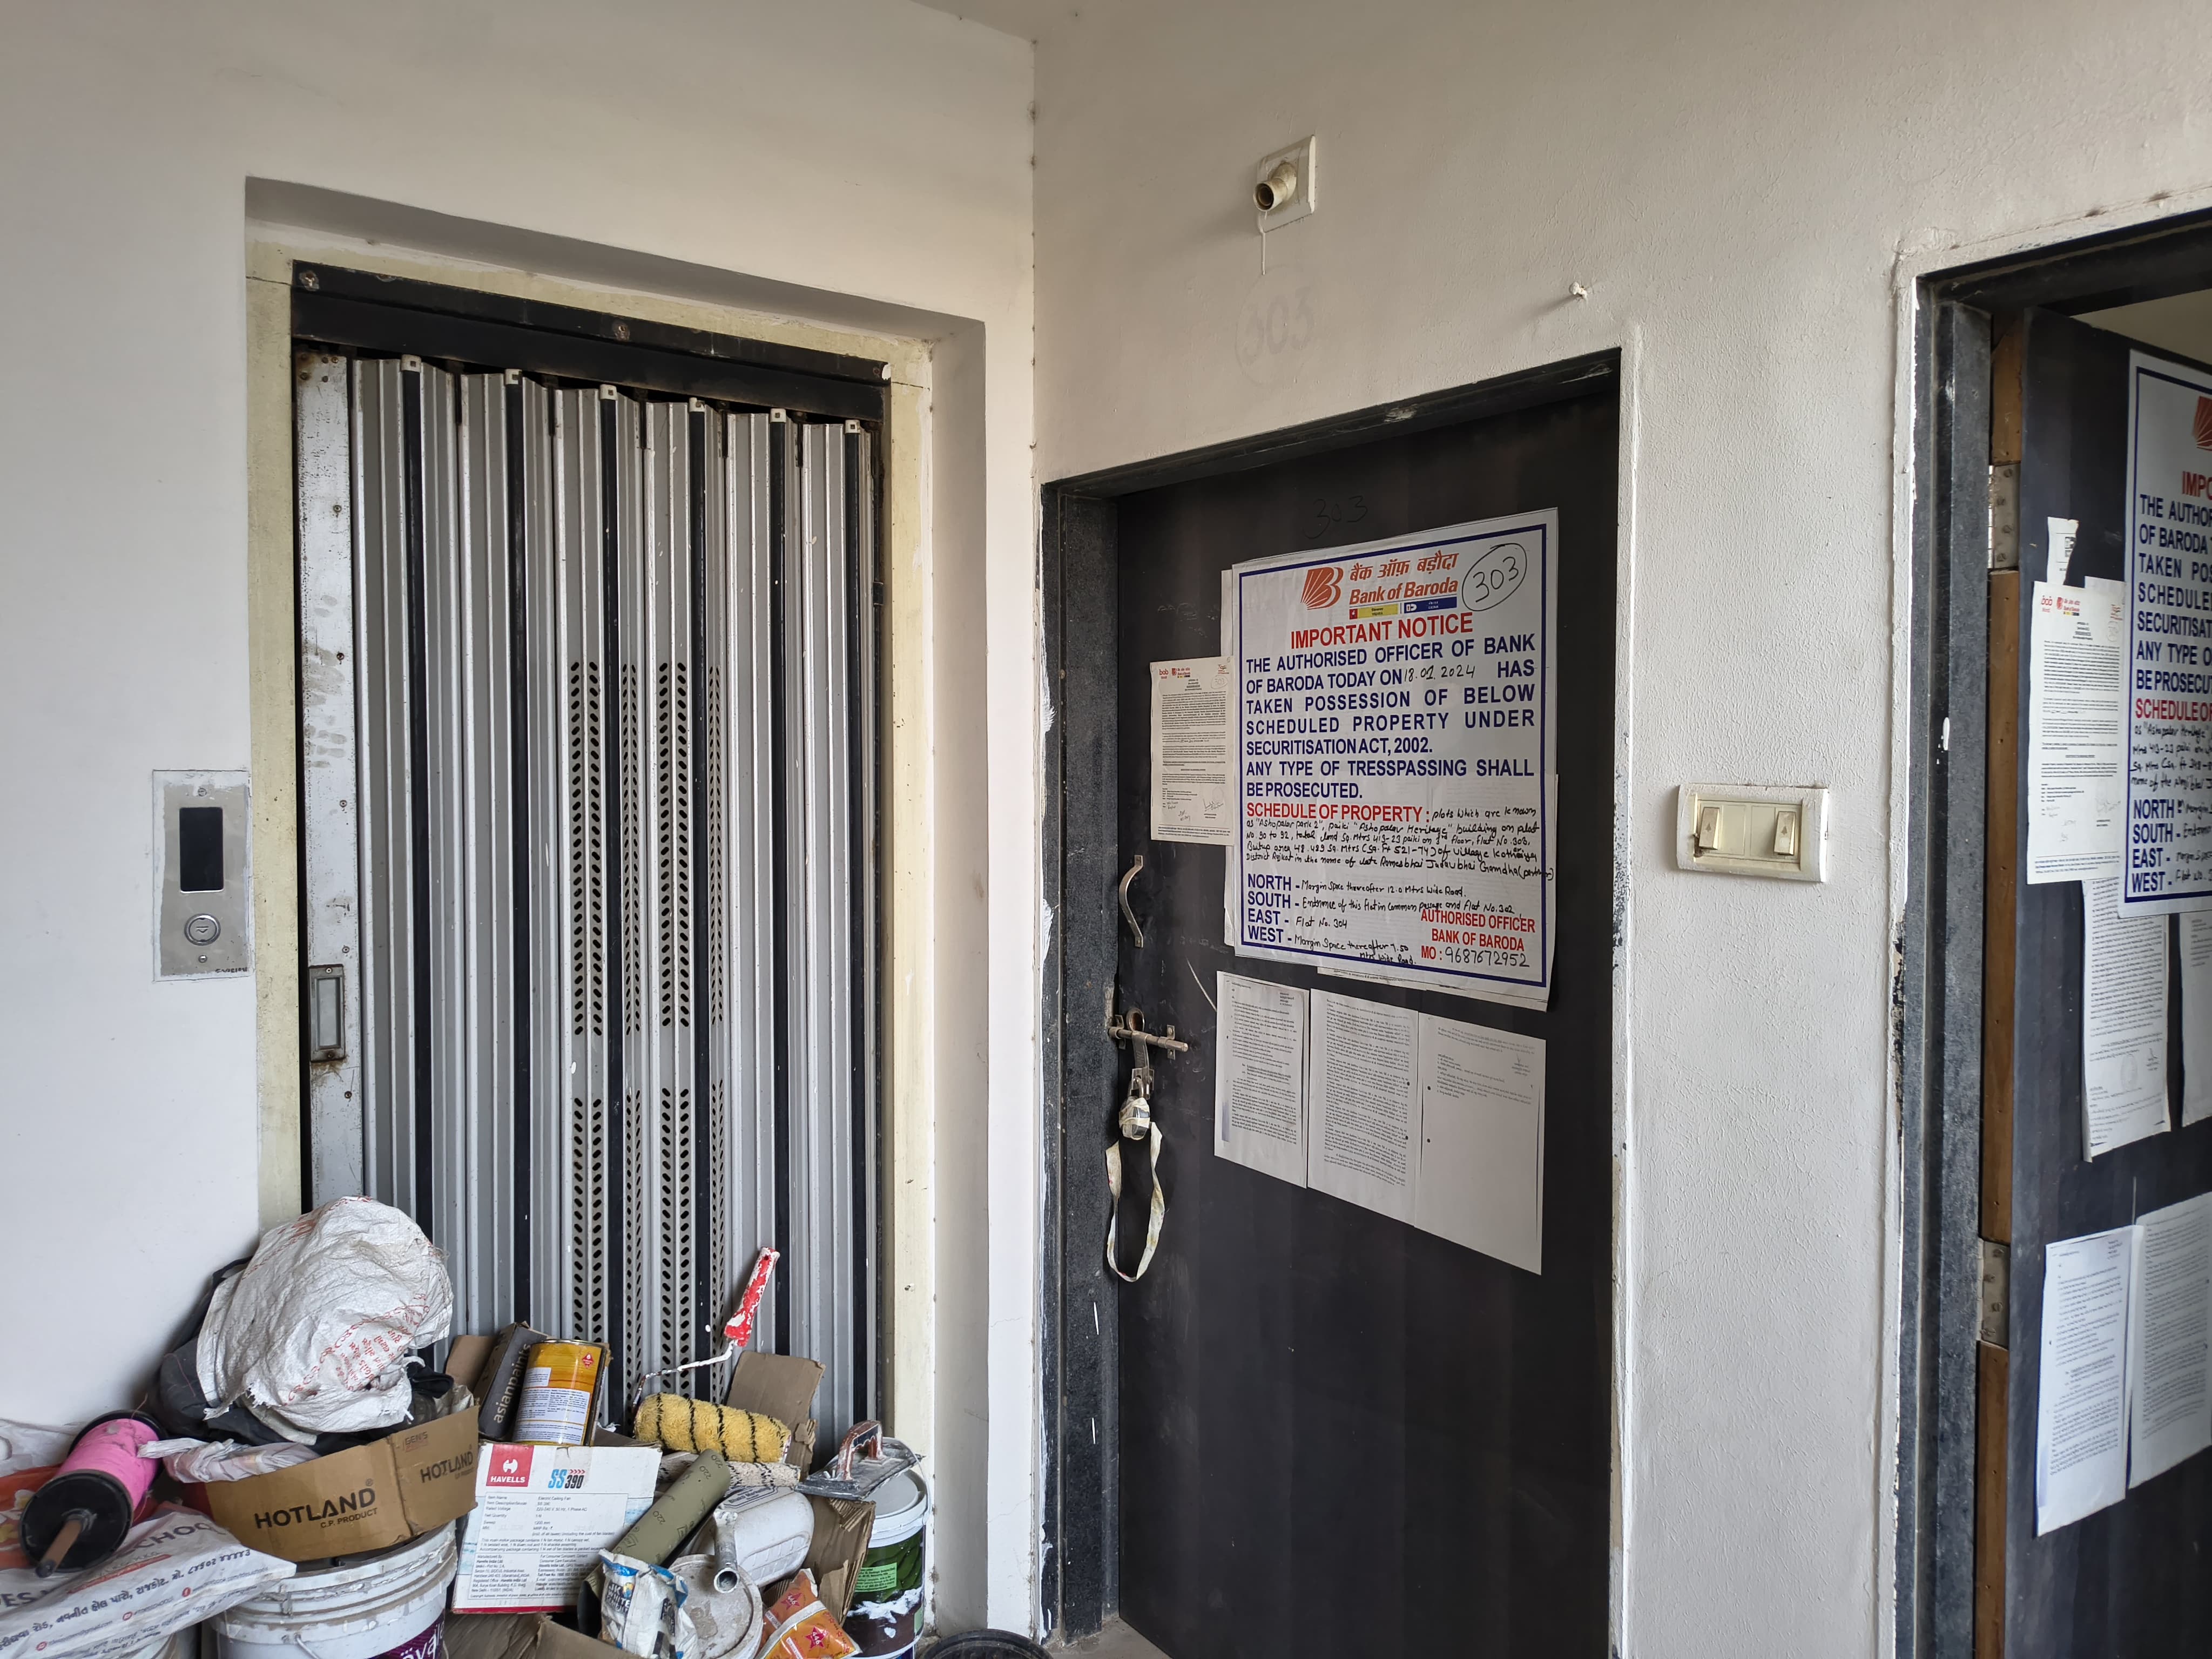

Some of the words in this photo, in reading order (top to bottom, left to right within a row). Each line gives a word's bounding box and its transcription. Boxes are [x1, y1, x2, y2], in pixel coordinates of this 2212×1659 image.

[1302, 495, 1368, 539] 303
[2140, 494, 2163, 518] THE
[2140, 523, 2156, 545] OF
[2159, 527, 2208, 555] BARODA
[1350, 562, 1373, 582] बैंक
[1417, 550, 1459, 574] बड़ौदा
[2139, 552, 2182, 578] TAKEN
[1350, 586, 1386, 605] Bank
[1387, 583, 1403, 600] of
[1404, 577, 1458, 598] Baroda
[1473, 556, 1519, 603] 303
[2138, 582, 2212, 612] SCHEDULE
[1291, 621, 1392, 649] IMPORTANT
[1398, 612, 1473, 639] NOTICE
[1246, 657, 1271, 673] THE
[1277, 649, 1367, 671] AUTHORISED
[1375, 642, 1443, 663] OFFICER
[1452, 639, 1474, 657] OF
[1485, 633, 1535, 655] BANK
[2136, 640, 2162, 662] ANY
[2168, 643, 2197, 665] TYPE
[1246, 679, 1263, 694] OF
[1267, 675, 1324, 693] BARODA
[1328, 671, 1376, 689] TODAY
[1380, 669, 1402, 685] ON
[1498, 659, 1535, 678] HAS
[2137, 669, 2152, 690] BE
[1246, 698, 1292, 714] TAKEN
[1305, 691, 1410, 711] POSSESSION
[1425, 689, 1448, 706] OF
[1464, 684, 1535, 704] BELOW
[2136, 698, 2198, 721] SCHEDULE
[1246, 717, 1339, 735] SCHEDULED
[1353, 712, 1449, 731] PROPERTY
[1465, 709, 1535, 729] UNDER
[1246, 738, 1356, 756] SECURITISATION
[1358, 738, 1391, 756] ACT,
[1394, 737, 1433, 753] 2002.
[1246, 761, 1272, 776] ANY
[1279, 761, 1313, 776] TYPE
[1320, 760, 1339, 776] OF
[1348, 759, 1467, 777] TRESSPASSING
[1476, 759, 1534, 777] SHALL
[1246, 783, 1263, 797] BE
[1266, 783, 1363, 799] PROSECUTED.
[1247, 802, 1317, 819] SCHEDULE
[1319, 804, 1338, 819] OF
[1341, 804, 1423, 822] PROPERTY
[2134, 799, 2174, 819] NORTH
[2133, 823, 2173, 844] SOUTH
[2133, 847, 2163, 868] EAST
[1248, 873, 1291, 891] NORTH
[2132, 871, 2166, 893] WEST
[1248, 891, 1291, 909] SOUTH
[1248, 908, 1280, 925] EAST
[1421, 909, 1486, 928] AUTHORISED
[1489, 915, 1535, 933] OFFICER
[1248, 925, 1284, 943] WEST
[1432, 928, 1460, 944] BANK
[1462, 932, 1476, 945] OF
[1479, 934, 1525, 952] BARODA
[1445, 947, 1530, 967] 9687672952
[494, 1343, 531, 1424] asianpaints
[420, 1451, 474, 1483] HOTLAND
[254, 1488, 376, 1529] HOTLAND
[320, 1516, 336, 1528] C.P.
[337, 1507, 378, 1525] PRODUCT
[0, 1593, 37, 1608] ES
